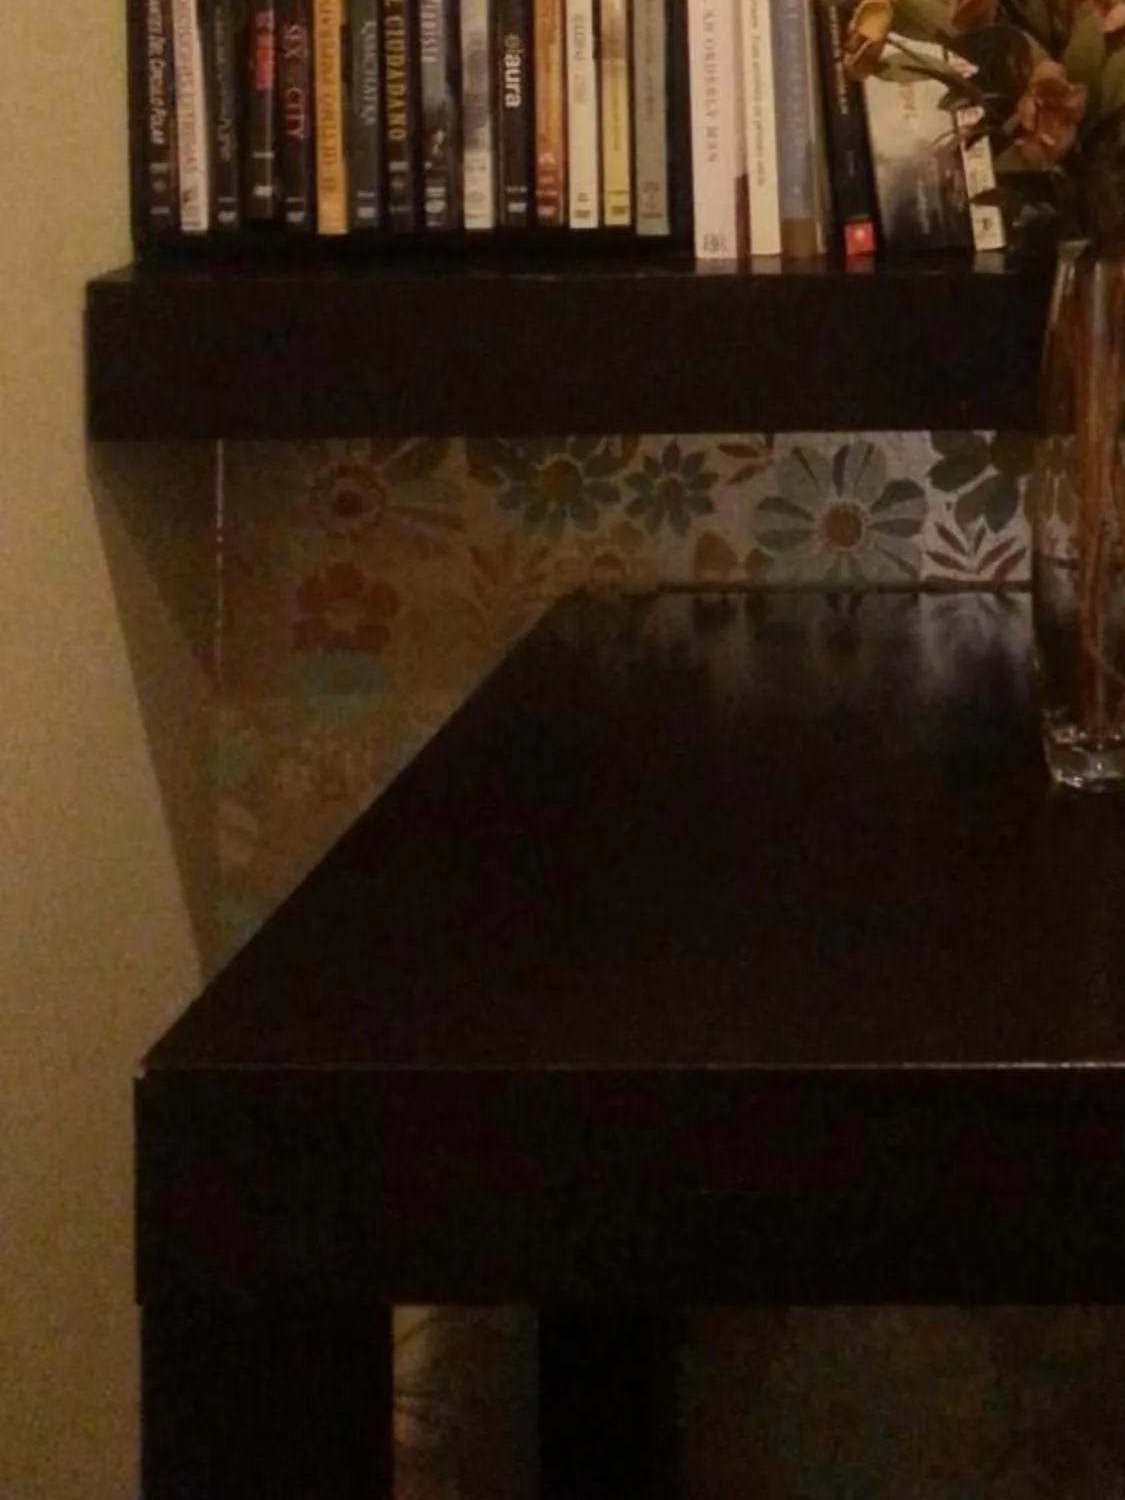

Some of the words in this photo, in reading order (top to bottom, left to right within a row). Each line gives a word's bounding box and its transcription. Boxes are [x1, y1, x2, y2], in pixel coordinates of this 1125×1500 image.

[284, 23, 302, 59] SEX
[361, 20, 378, 126] KAMCHATKA
[385, 14, 406, 142] CIUDADANO
[504, 53, 522, 108] aura
[701, 37, 719, 119] ORDERLY
[285, 86, 305, 139] CITY
